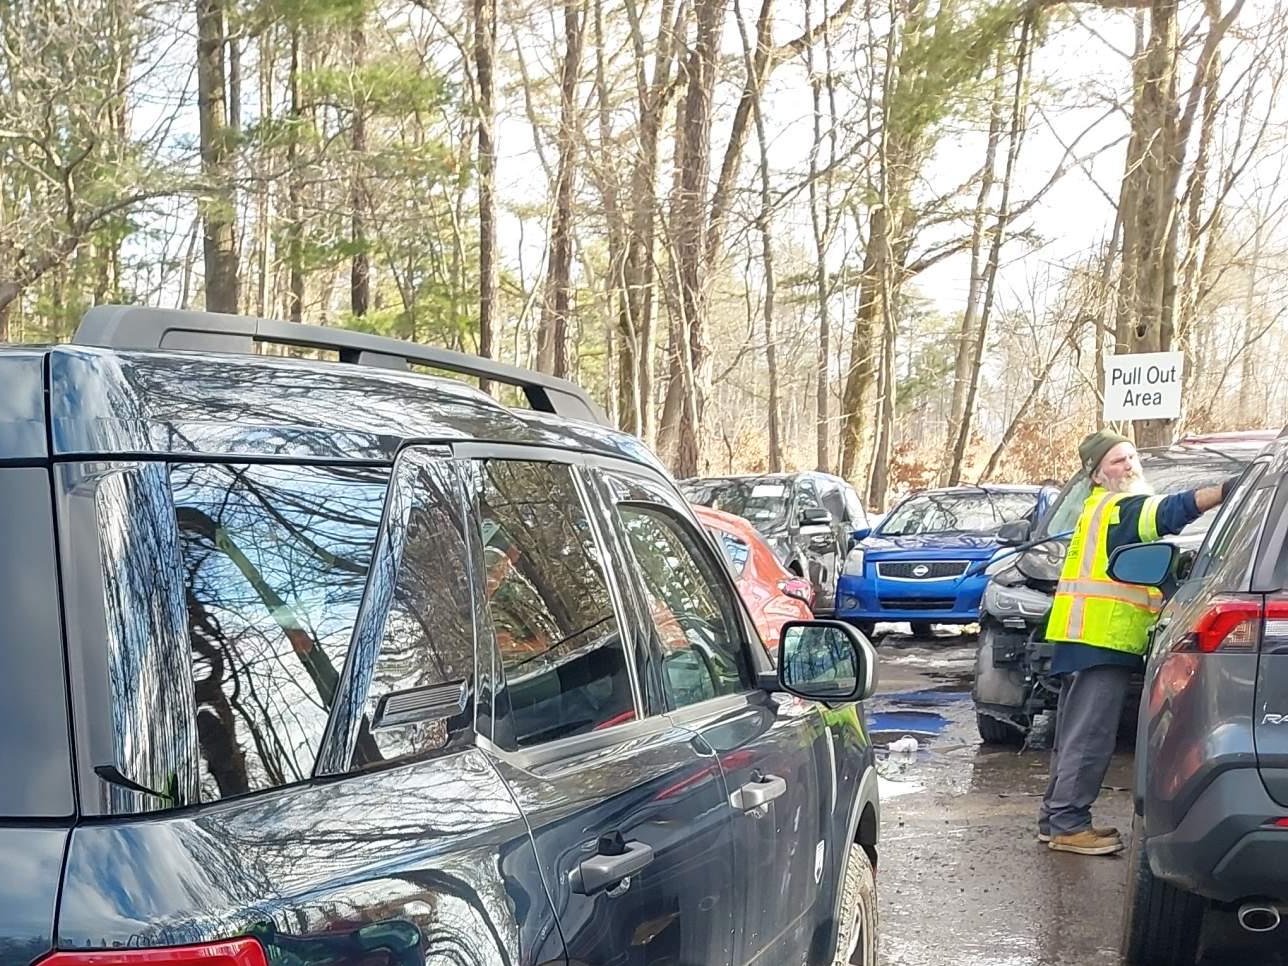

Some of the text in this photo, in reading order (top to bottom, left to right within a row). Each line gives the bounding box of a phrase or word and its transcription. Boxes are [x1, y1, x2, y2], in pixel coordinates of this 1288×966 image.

[1112, 365, 1177, 386] Pull Out
[1122, 390, 1162, 407] Area
